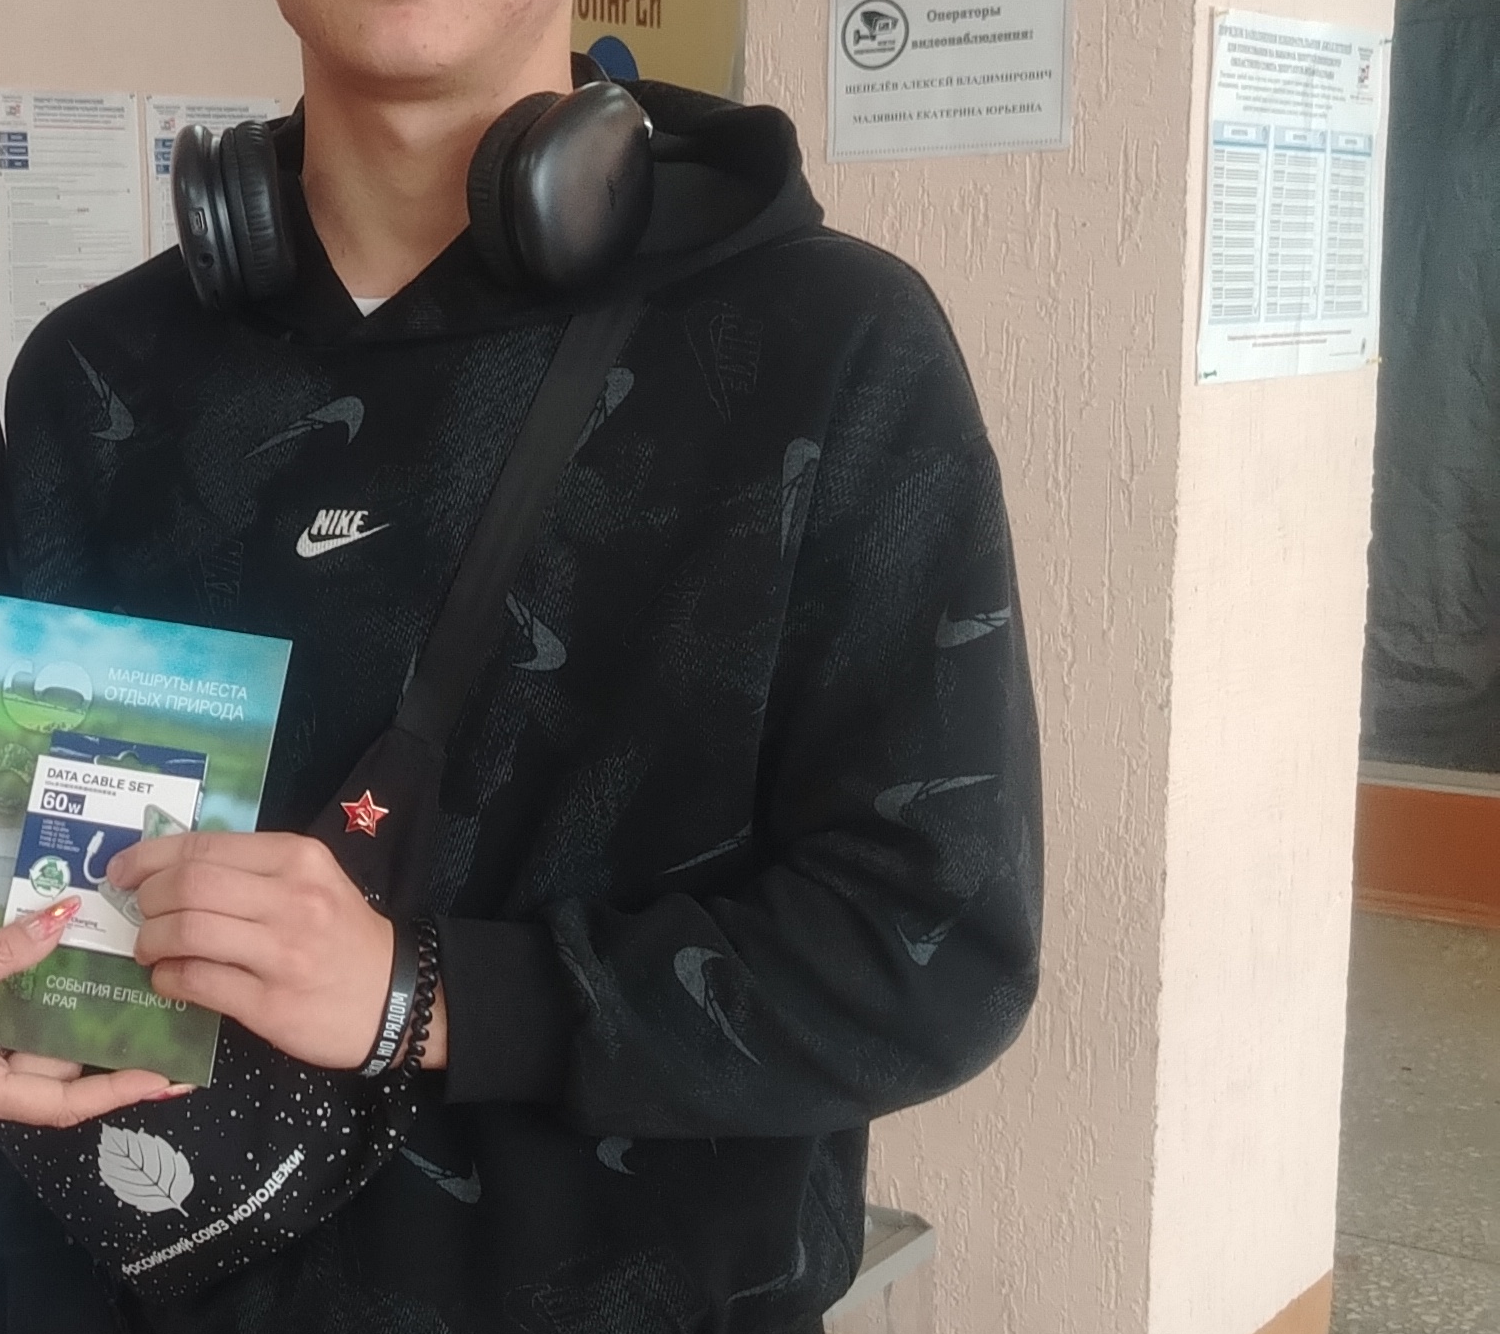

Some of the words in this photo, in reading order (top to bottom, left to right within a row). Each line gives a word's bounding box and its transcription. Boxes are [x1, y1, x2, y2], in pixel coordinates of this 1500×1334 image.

[926, 5, 1002, 24] Операторы
[901, 75, 953, 91] АЛЕКСЕЙ
[956, 69, 1053, 87] ВЛАДИМИРОВИЧ
[916, 107, 983, 121] ЕКАТЕРИНА
[985, 102, 1043, 117] ЮРЬЕВНА
[311, 509, 369, 536] NIKE
[108, 667, 194, 692] МАРШРУТЫ
[196, 679, 248, 701] МЕСТА
[104, 685, 162, 708] ОТДЫХ
[165, 694, 244, 721] ПРИРОДА
[46, 767, 78, 783] DATA
[82, 773, 125, 790] CABLE
[127, 780, 155, 794] SET
[46, 974, 111, 998] СОБЫТИЯ
[42, 992, 77, 1011] КРАЯ
[383, 991, 408, 1040] РЯДОМ
[376, 1040, 396, 1057] НО
[121, 1236, 195, 1277] РОССИЙСКИЙ
[191, 1218, 230, 1244] СОЮЗ
